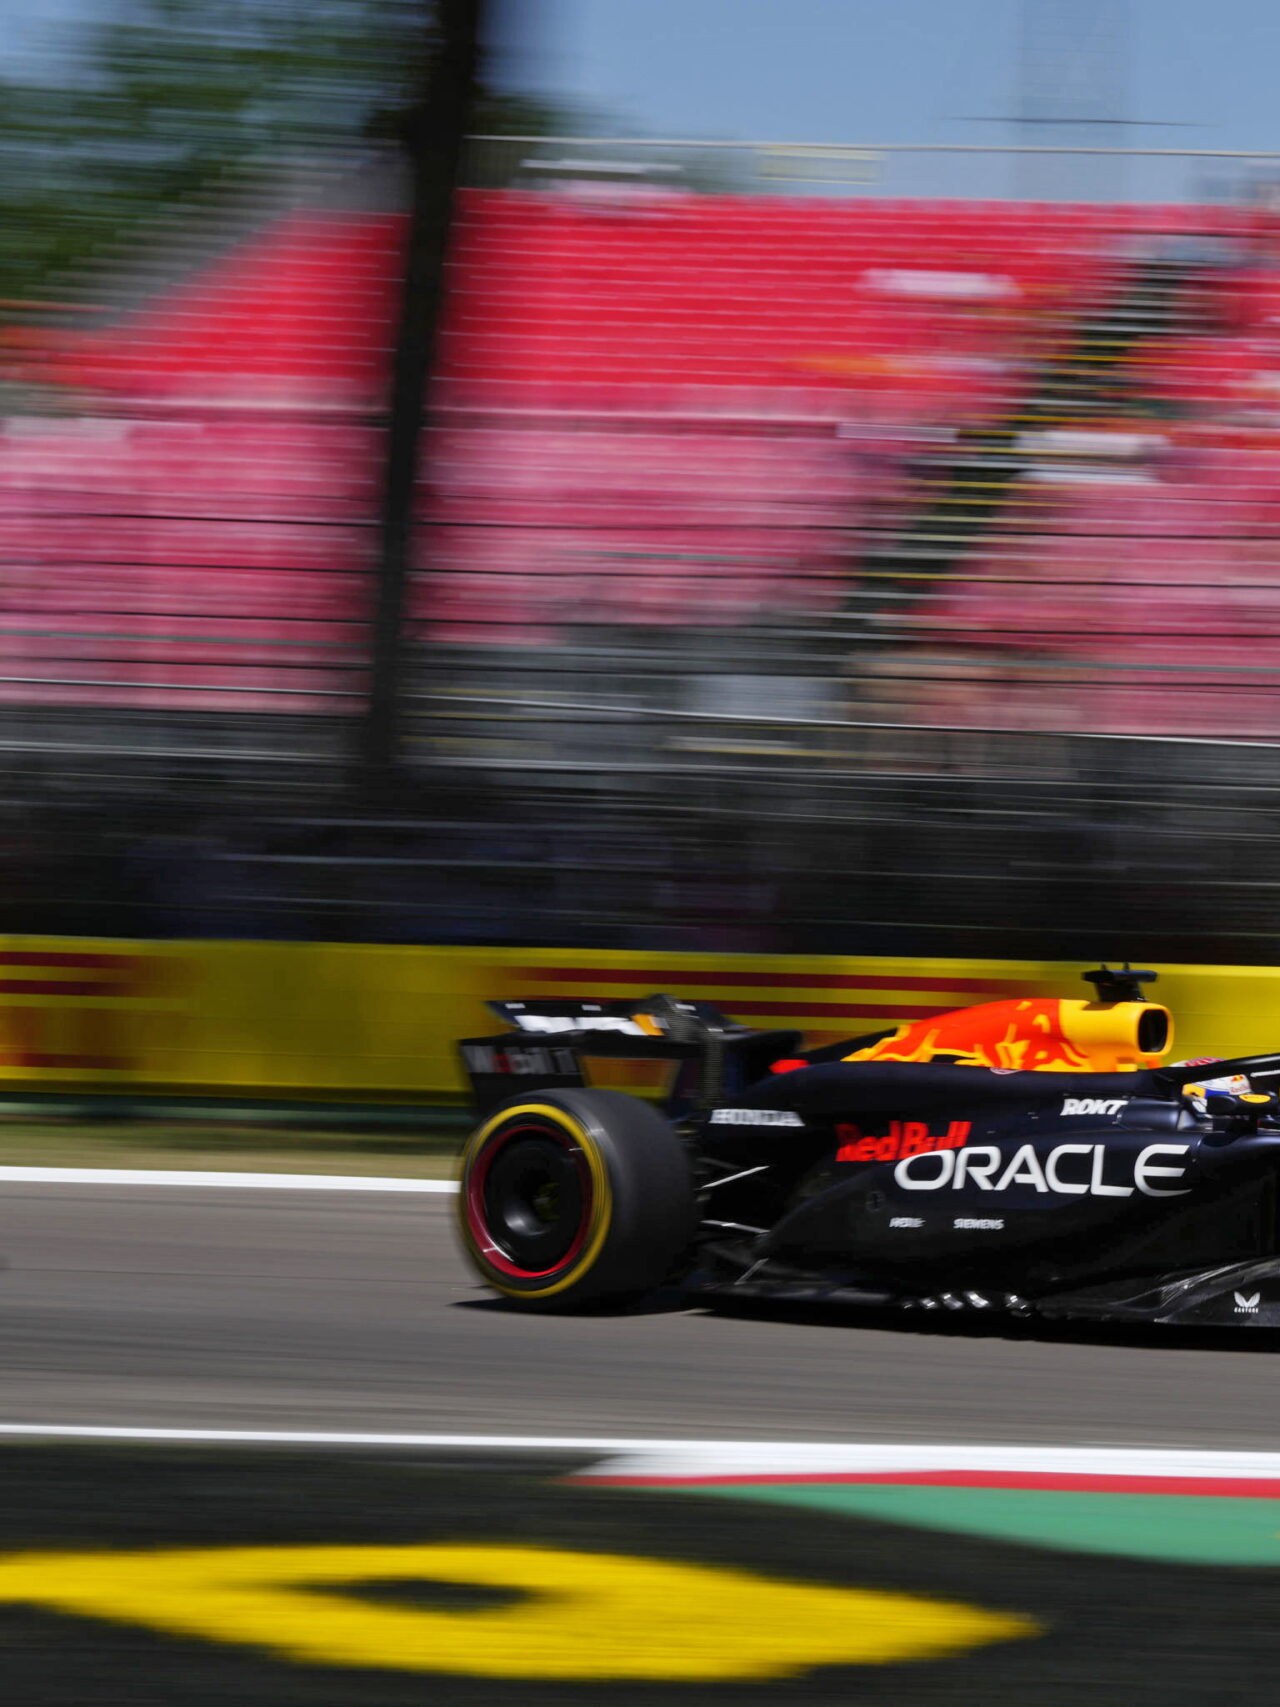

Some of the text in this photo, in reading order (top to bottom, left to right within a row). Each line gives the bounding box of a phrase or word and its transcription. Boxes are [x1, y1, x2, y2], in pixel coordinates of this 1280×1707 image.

[1060, 1099, 1128, 1116] ROKT
[708, 1109, 805, 1126] HONDA
[834, 1120, 972, 1162] Red Bull
[894, 1144, 1192, 1197] ORACLE
[953, 1218, 1005, 1230] SIEMENS
